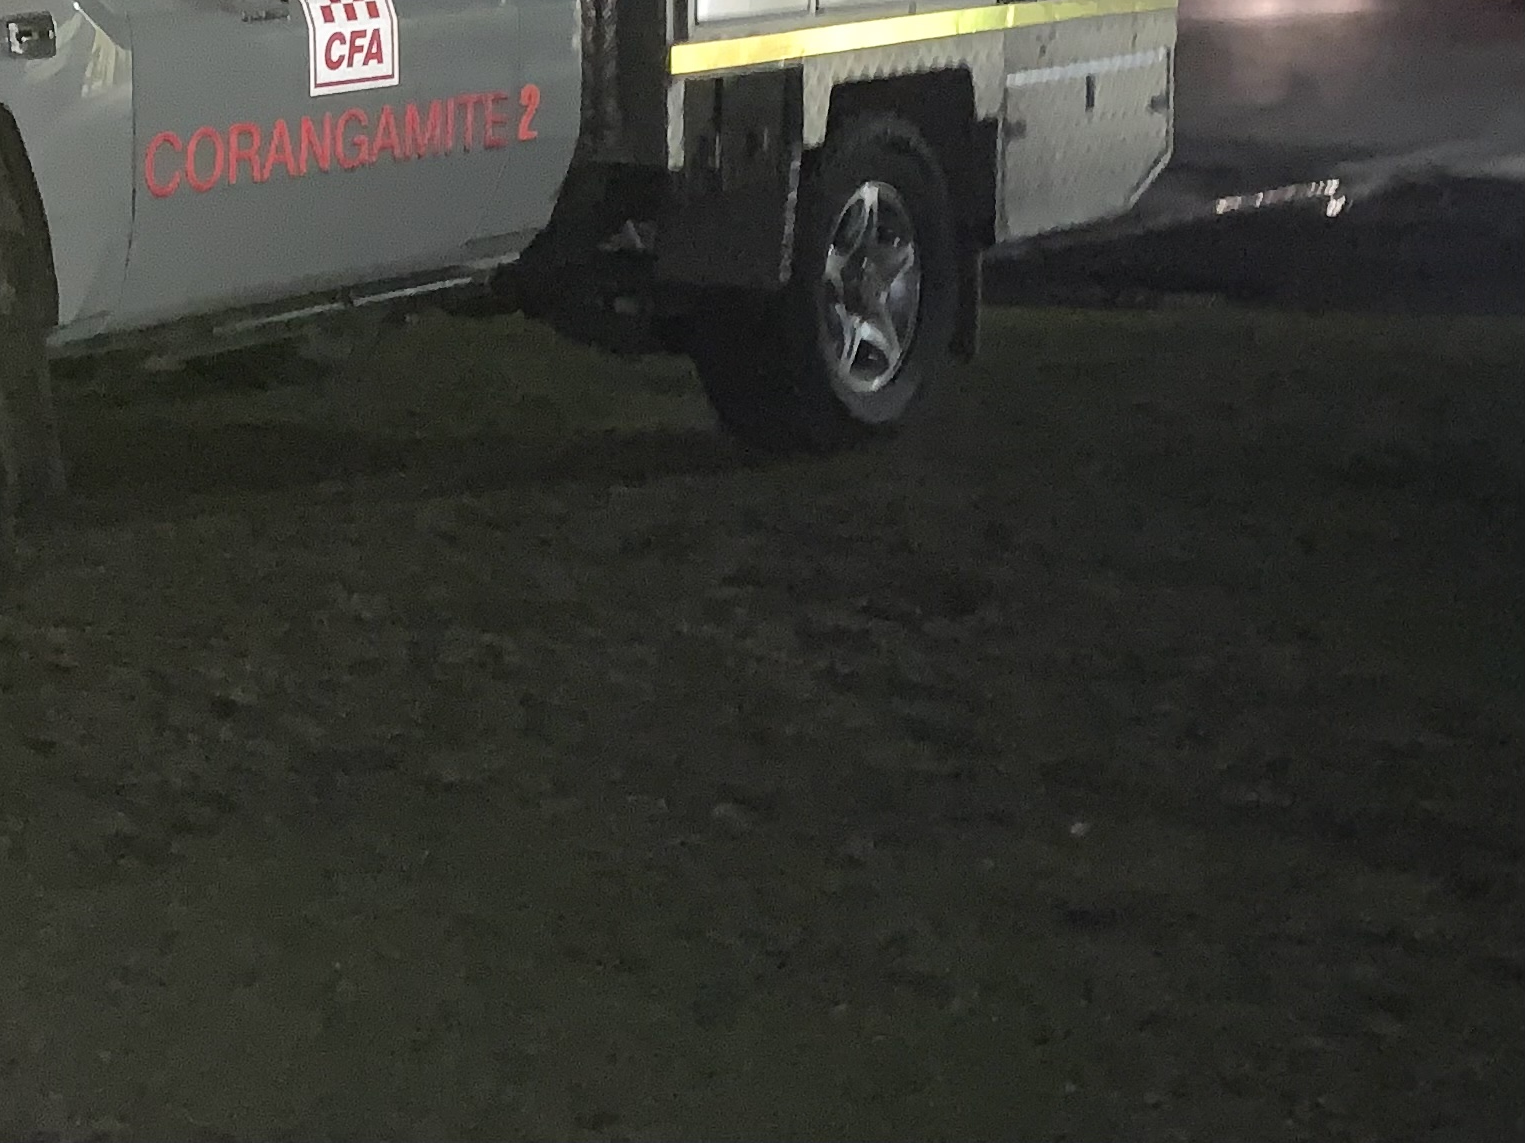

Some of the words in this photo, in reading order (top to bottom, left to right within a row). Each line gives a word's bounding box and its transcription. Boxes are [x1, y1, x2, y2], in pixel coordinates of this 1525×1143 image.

[324, 28, 384, 71] CFA
[144, 90, 510, 198] CORANGAMITE
[517, 83, 541, 142] 2
